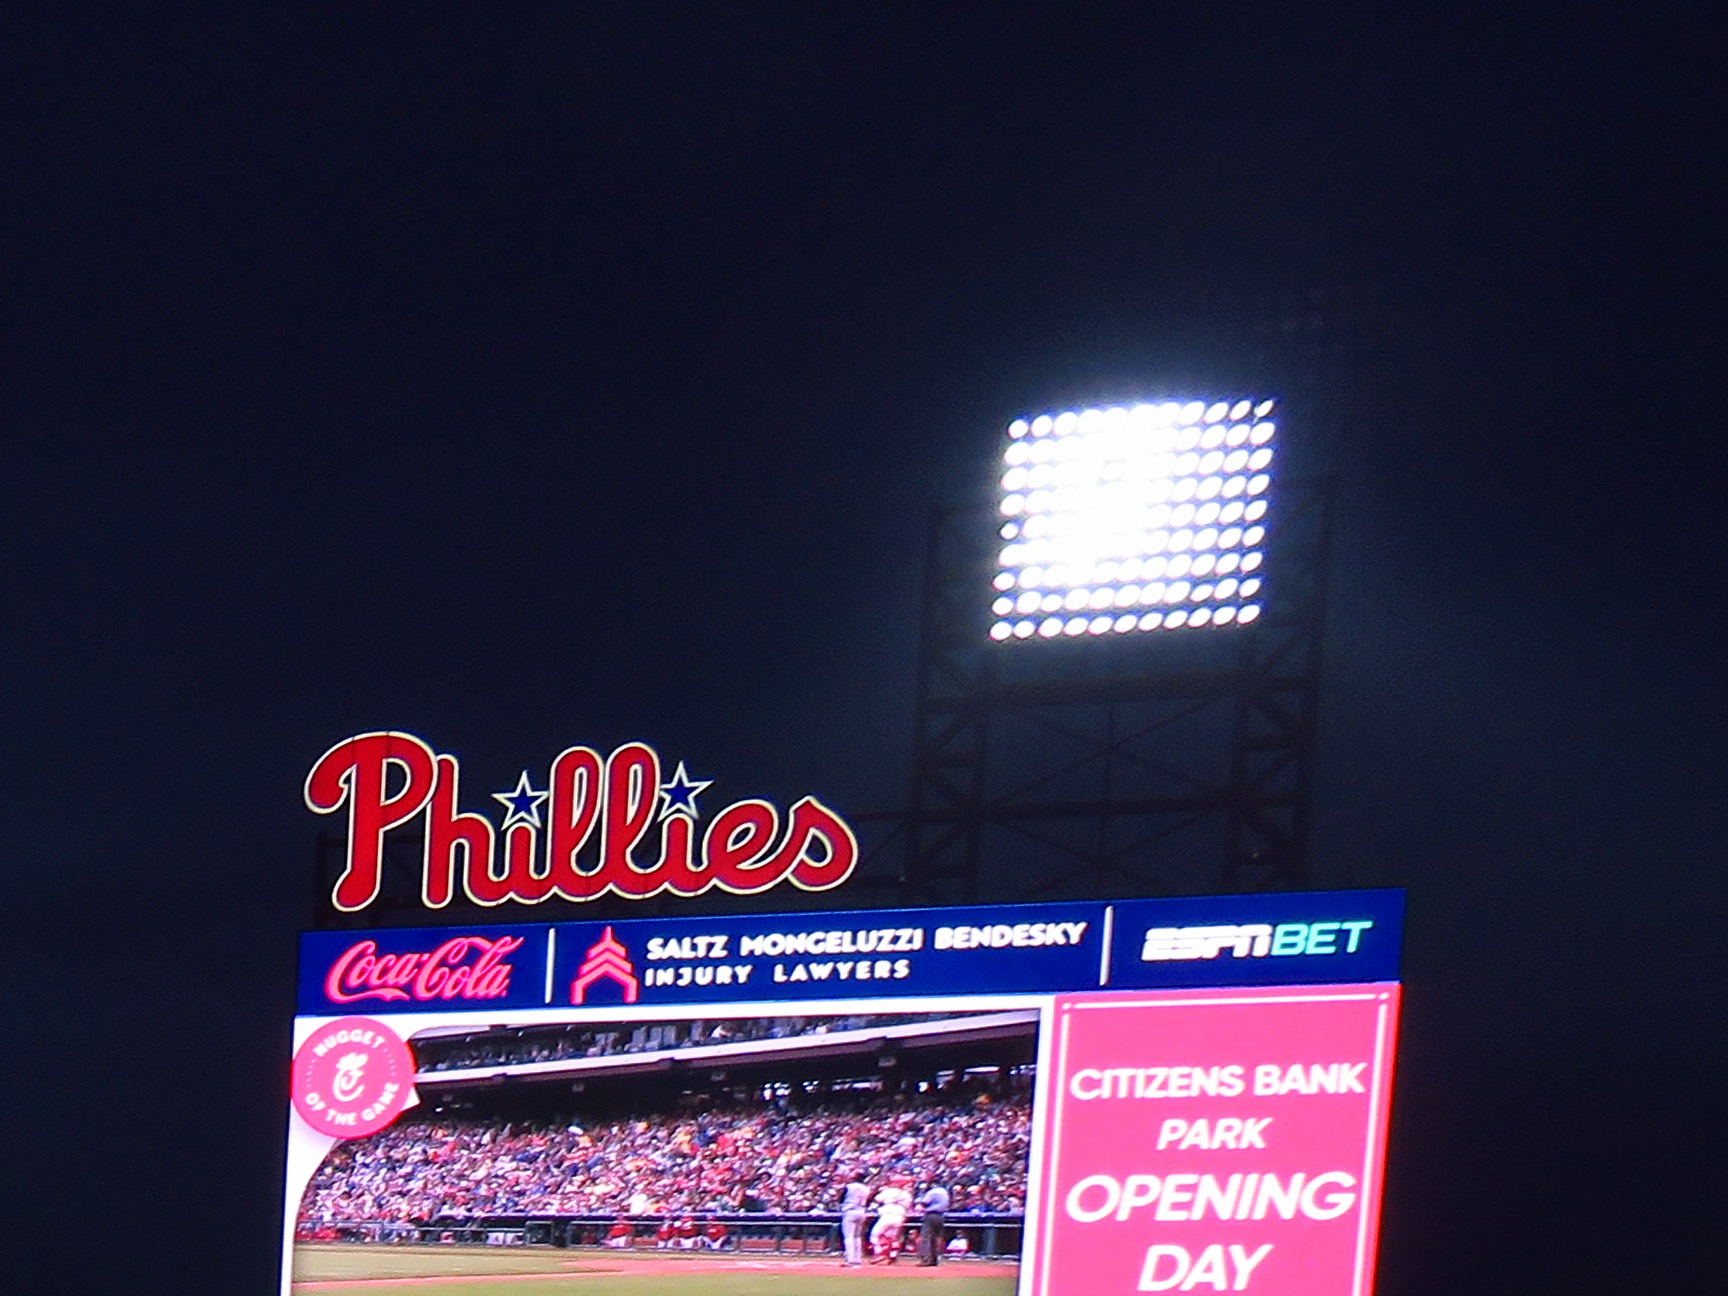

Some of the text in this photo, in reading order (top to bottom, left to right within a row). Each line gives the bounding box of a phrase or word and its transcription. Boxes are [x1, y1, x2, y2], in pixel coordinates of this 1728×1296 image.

[304, 731, 858, 911] Phillies
[646, 921, 1088, 960] SALTZ MONGELUZZI BENDESKY
[1271, 920, 1373, 955] BET
[324, 935, 524, 1001] Coca-Cola
[645, 957, 910, 988] INJURY LAWYERS
[313, 1029, 385, 1057] NUGGET
[1069, 1062, 1367, 1101] CITIZENS BANK
[1156, 1117, 1274, 1151] PARK
[1065, 1170, 1357, 1223] OPENING
[1137, 1244, 1274, 1291] DAY
